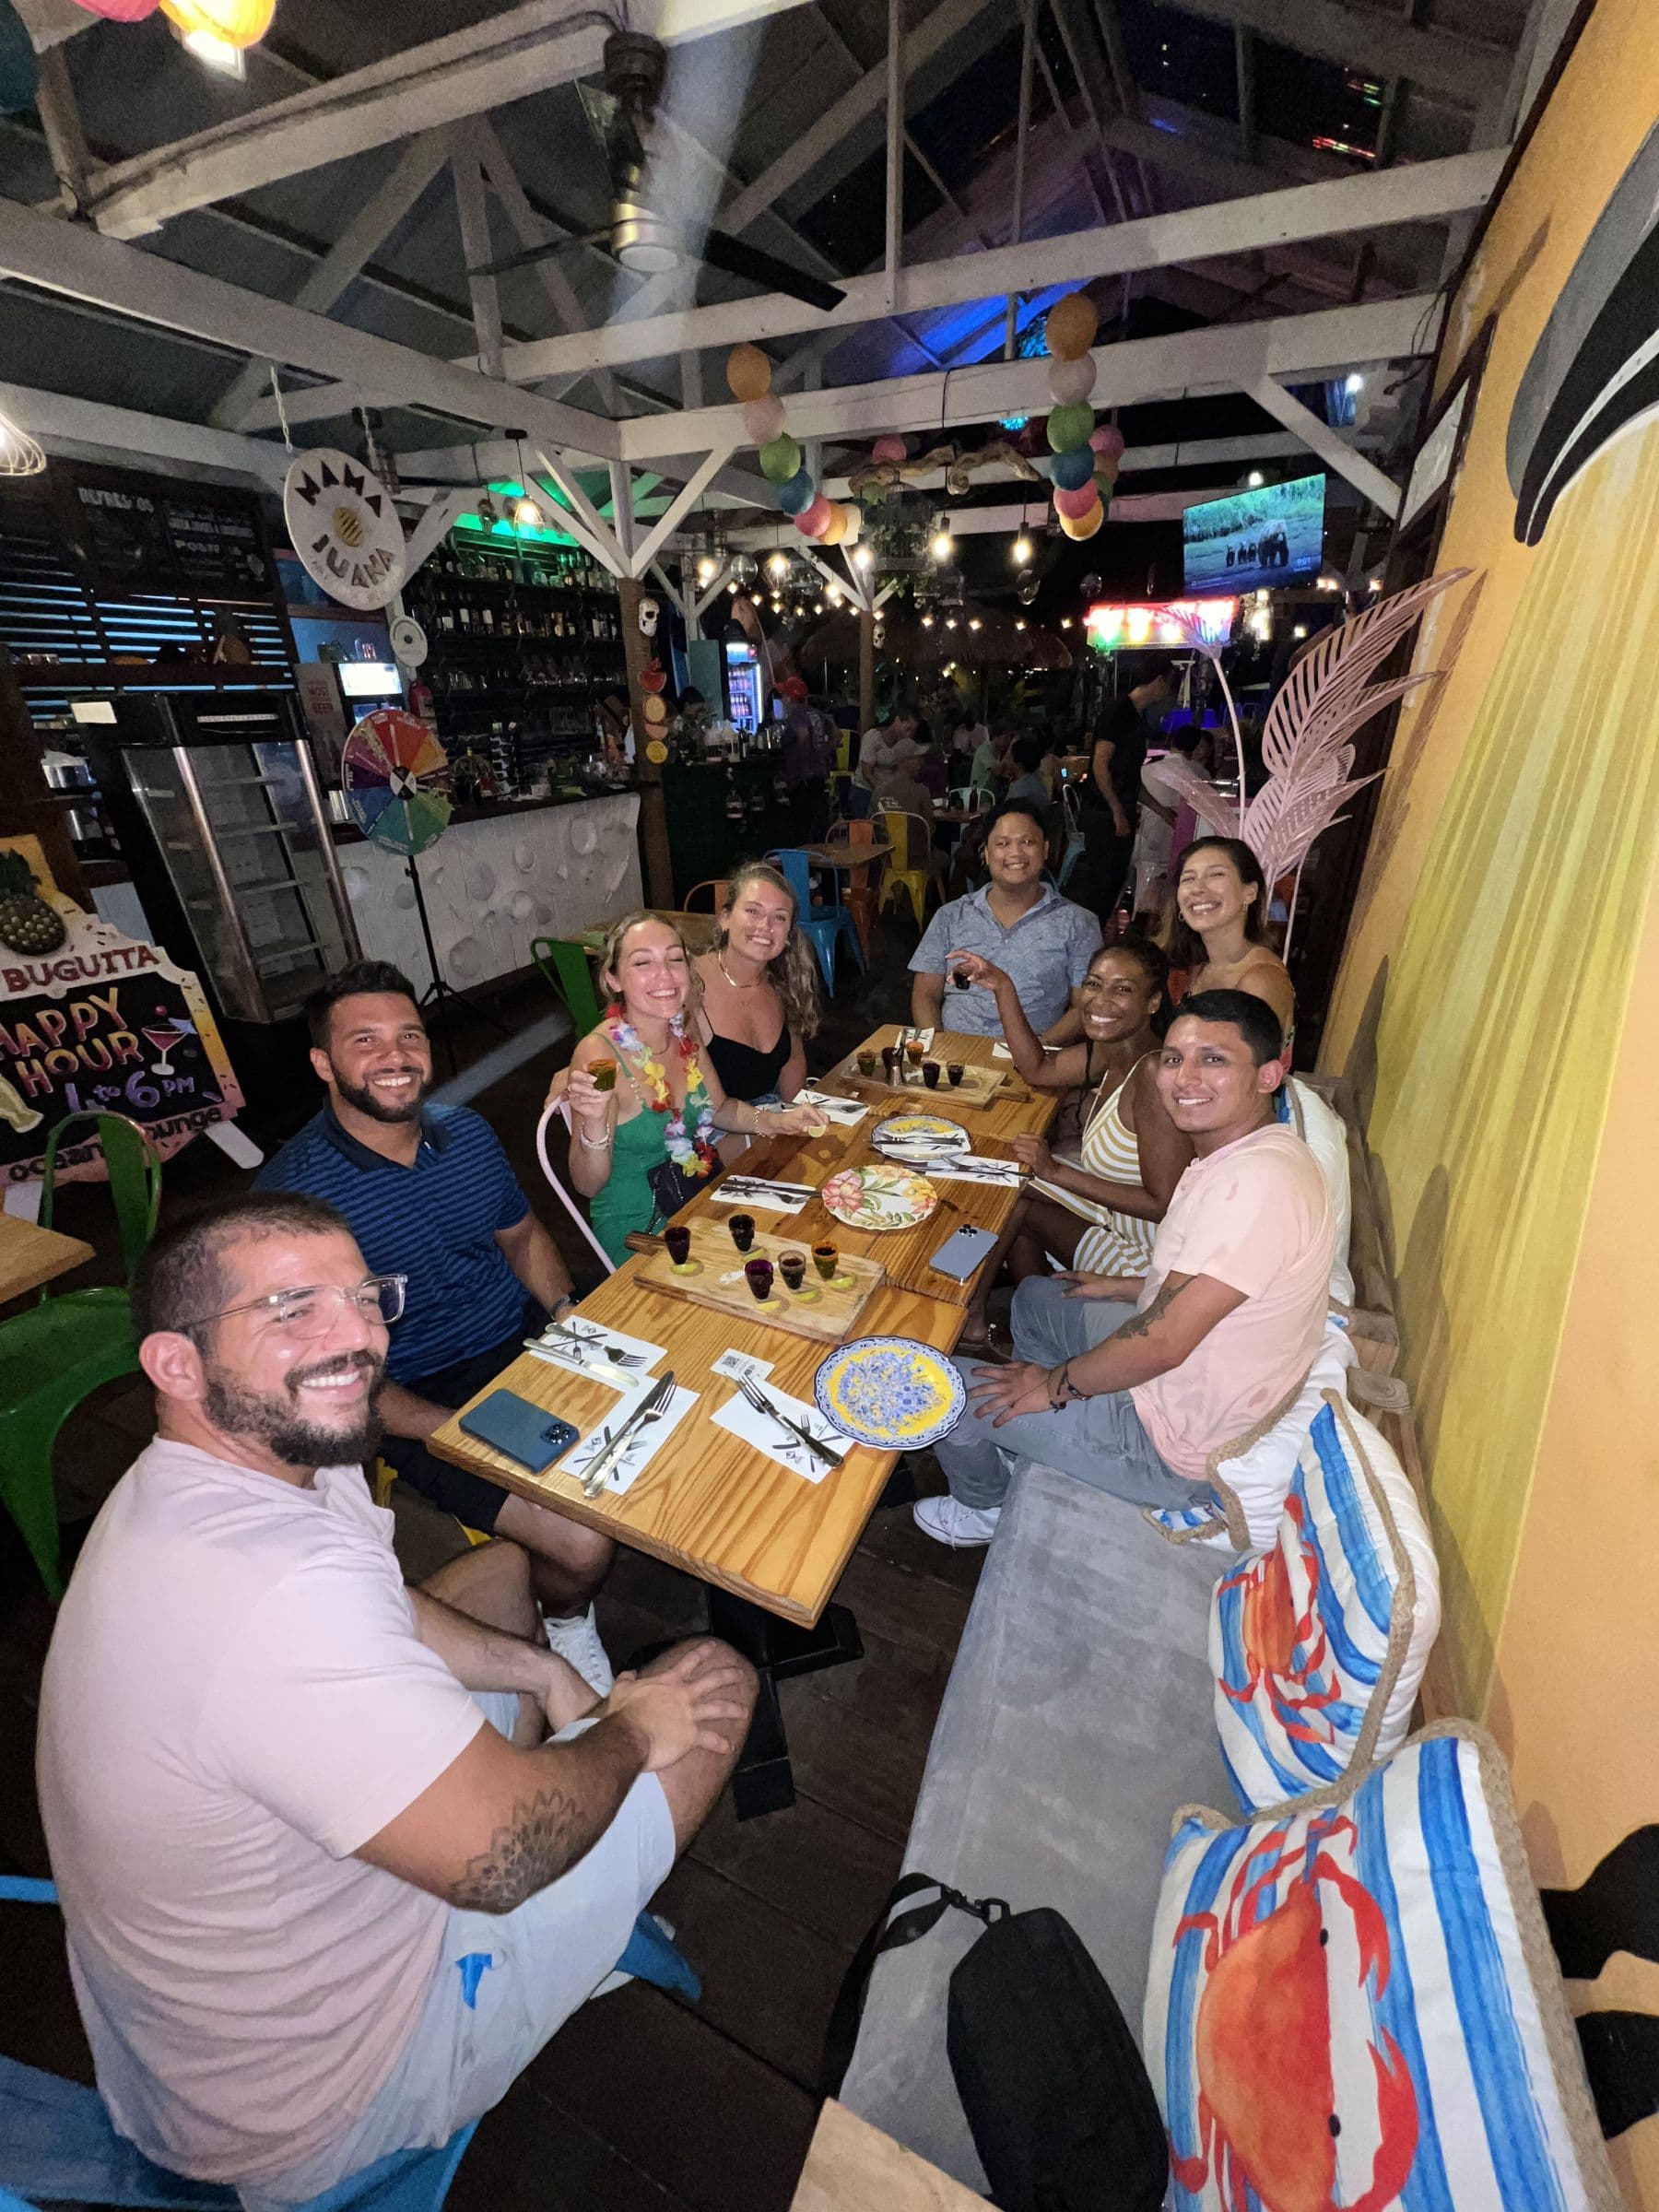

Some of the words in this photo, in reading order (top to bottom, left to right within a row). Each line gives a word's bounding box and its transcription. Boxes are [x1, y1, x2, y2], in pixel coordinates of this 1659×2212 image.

[294, 460, 382, 518] MAMA
[2, 945, 159, 992] BUGUITA
[15, 1030, 145, 1097] HOUR
[93, 1084, 121, 1101] to
[125, 1070, 160, 1108] 6
[161, 1077, 195, 1097] PM
